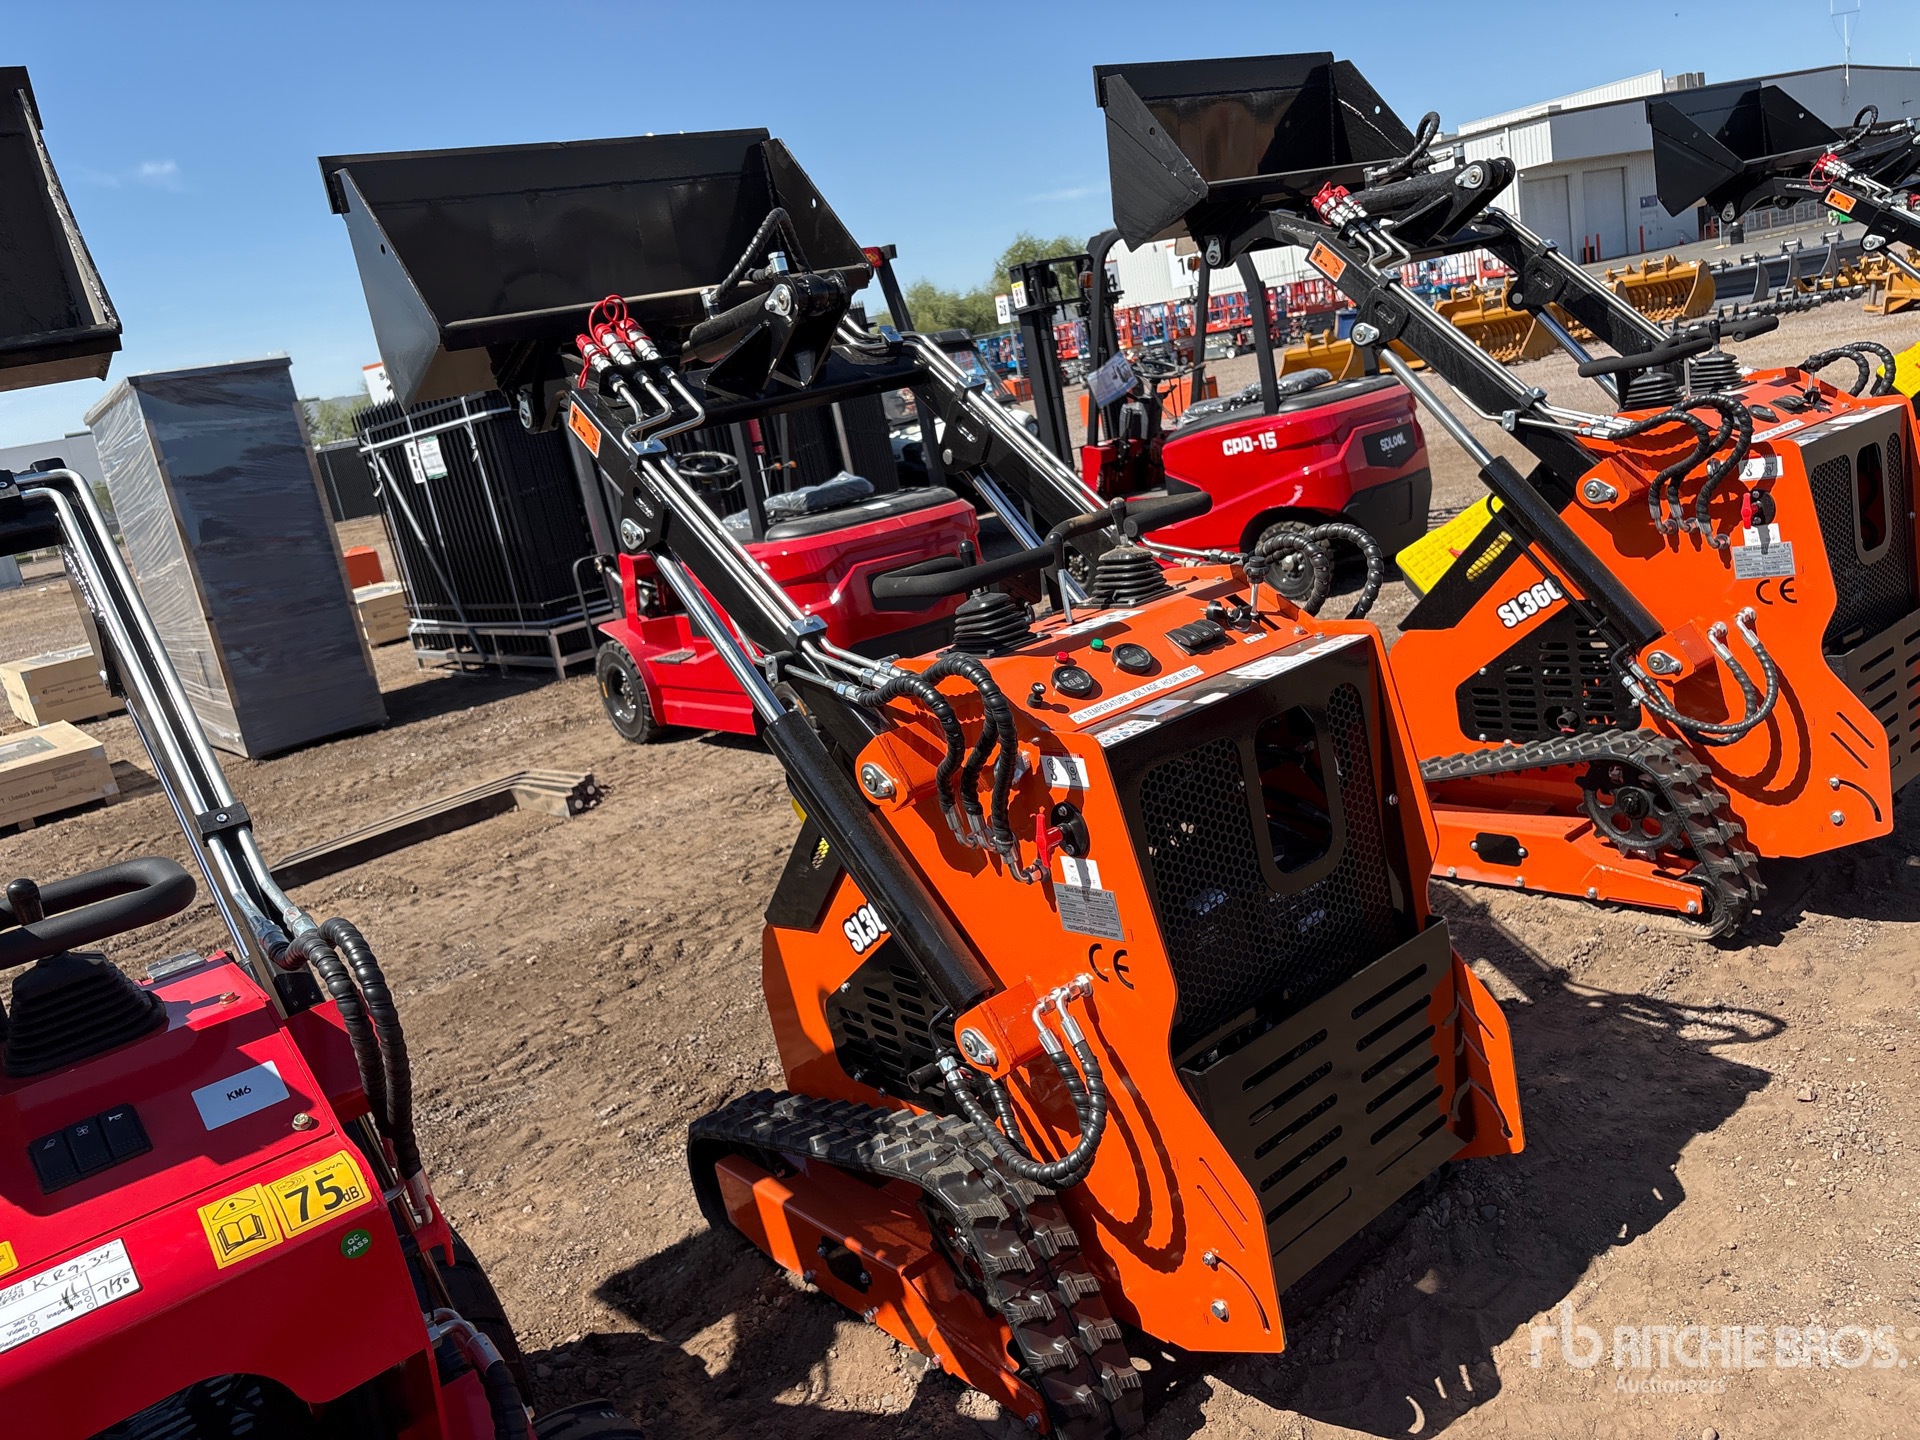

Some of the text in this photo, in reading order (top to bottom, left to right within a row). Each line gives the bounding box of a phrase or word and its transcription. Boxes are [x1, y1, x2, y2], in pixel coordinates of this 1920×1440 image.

[1222, 431, 1278, 457] CPD-15
[1755, 577, 1798, 606] CE
[1131, 683, 1161, 698] VOLTAGE
[1161, 676, 1180, 687] HOUR
[1180, 667, 1201, 680] METER
[1088, 942, 1134, 989] CE
[226, 1085, 252, 1101] KM6
[347, 1233, 360, 1245] QC
[347, 1238, 369, 1256] PASS
